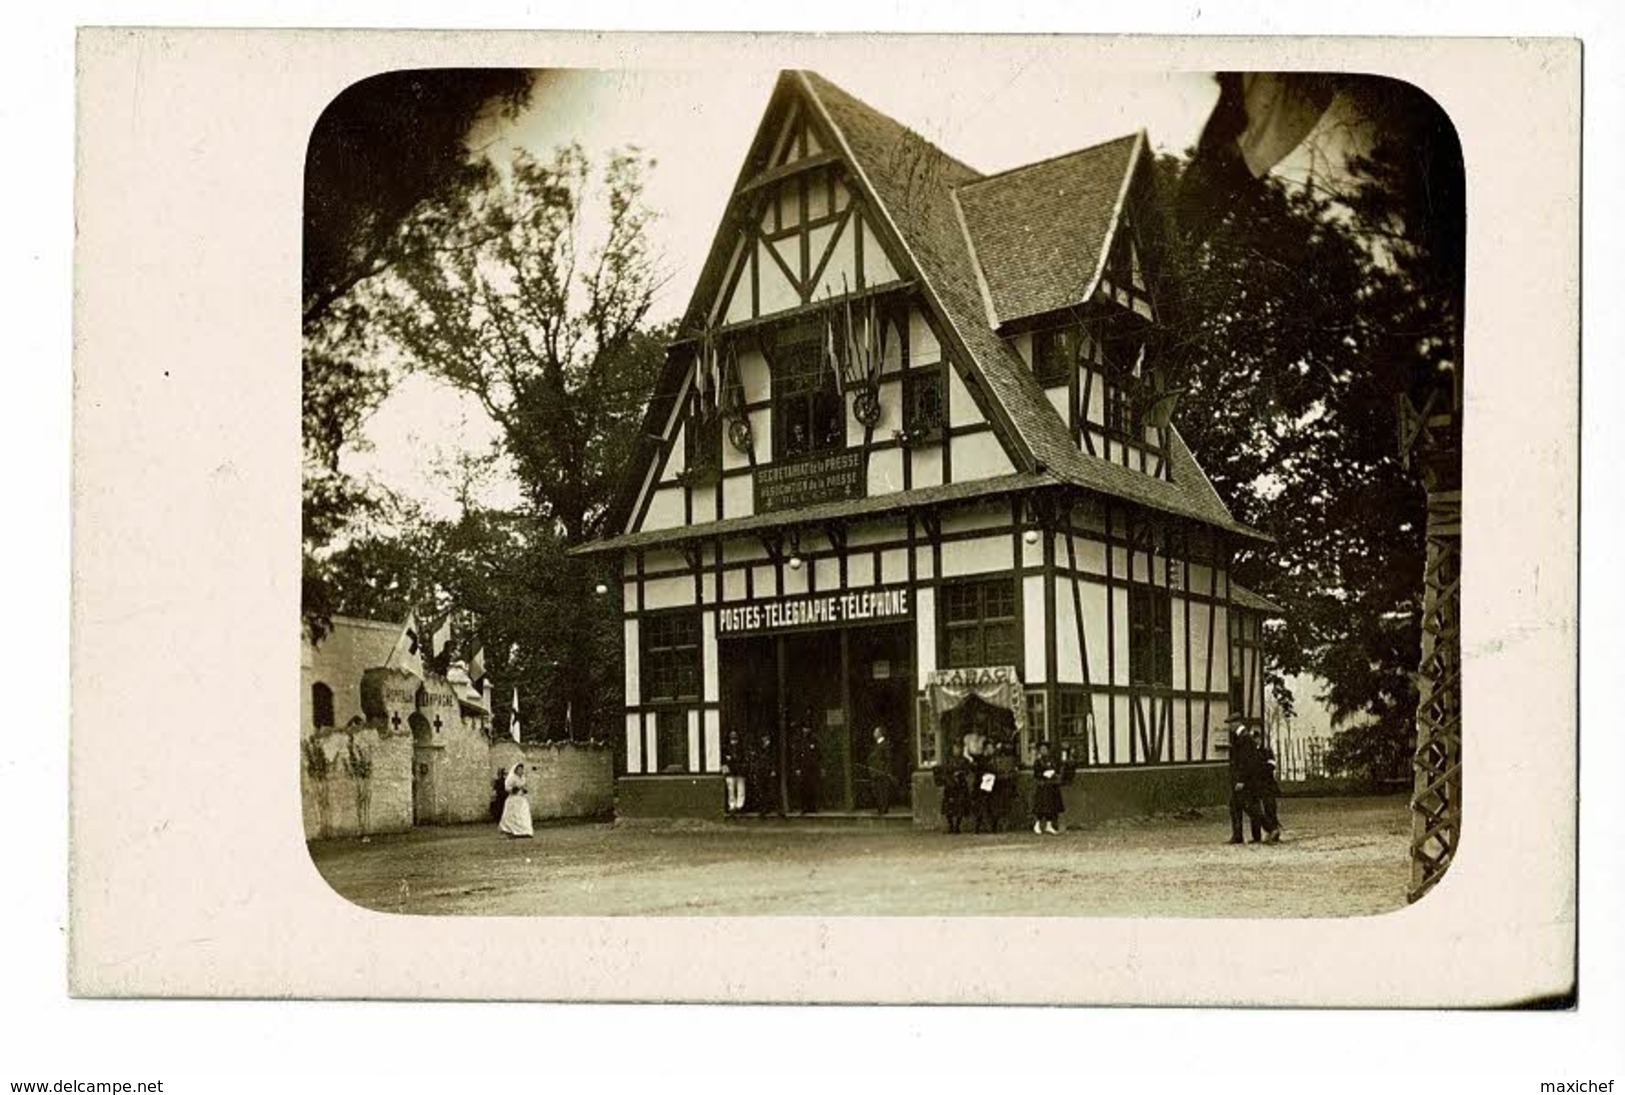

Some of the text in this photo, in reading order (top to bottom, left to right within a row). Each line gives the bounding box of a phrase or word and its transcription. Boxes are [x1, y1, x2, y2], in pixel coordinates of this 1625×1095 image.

[825, 454, 859, 472] PRESSE
[826, 472, 857, 488] PRESSE
[936, 667, 1008, 687] TABAC
